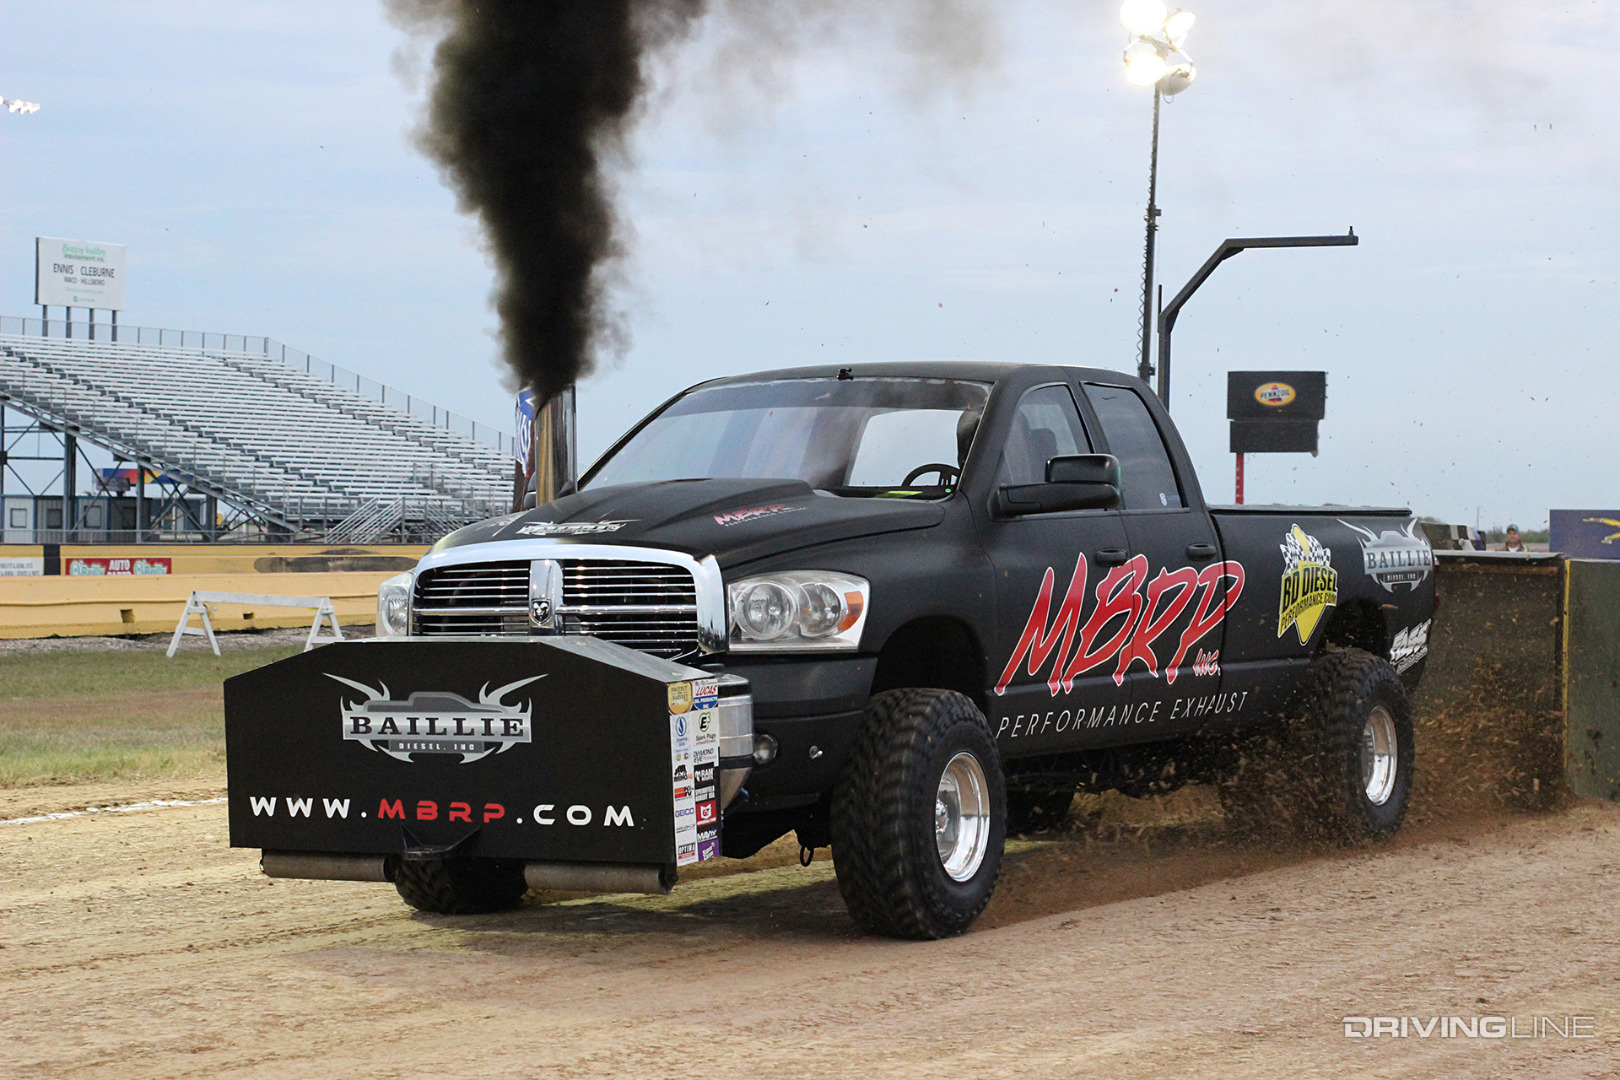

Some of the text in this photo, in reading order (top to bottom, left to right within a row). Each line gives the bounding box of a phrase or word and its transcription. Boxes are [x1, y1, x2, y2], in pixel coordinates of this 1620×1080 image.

[53, 263, 115, 278] ENNIS CLEBURNE
[80, 278, 105, 286] HILLSBORO
[109, 559, 130, 570] AUTO
[1366, 550, 1431, 569] BAILLIE
[1282, 567, 1337, 613] BD DIESEL
[994, 552, 1245, 697] MBRP
[696, 685, 717, 696] LUCAS
[996, 691, 1248, 739] PERFORMANCE EXHAUST
[350, 716, 523, 737] BAILLIE
[249, 796, 635, 827] WWW.MBRP.COM
[675, 808, 694, 817] GEICO
